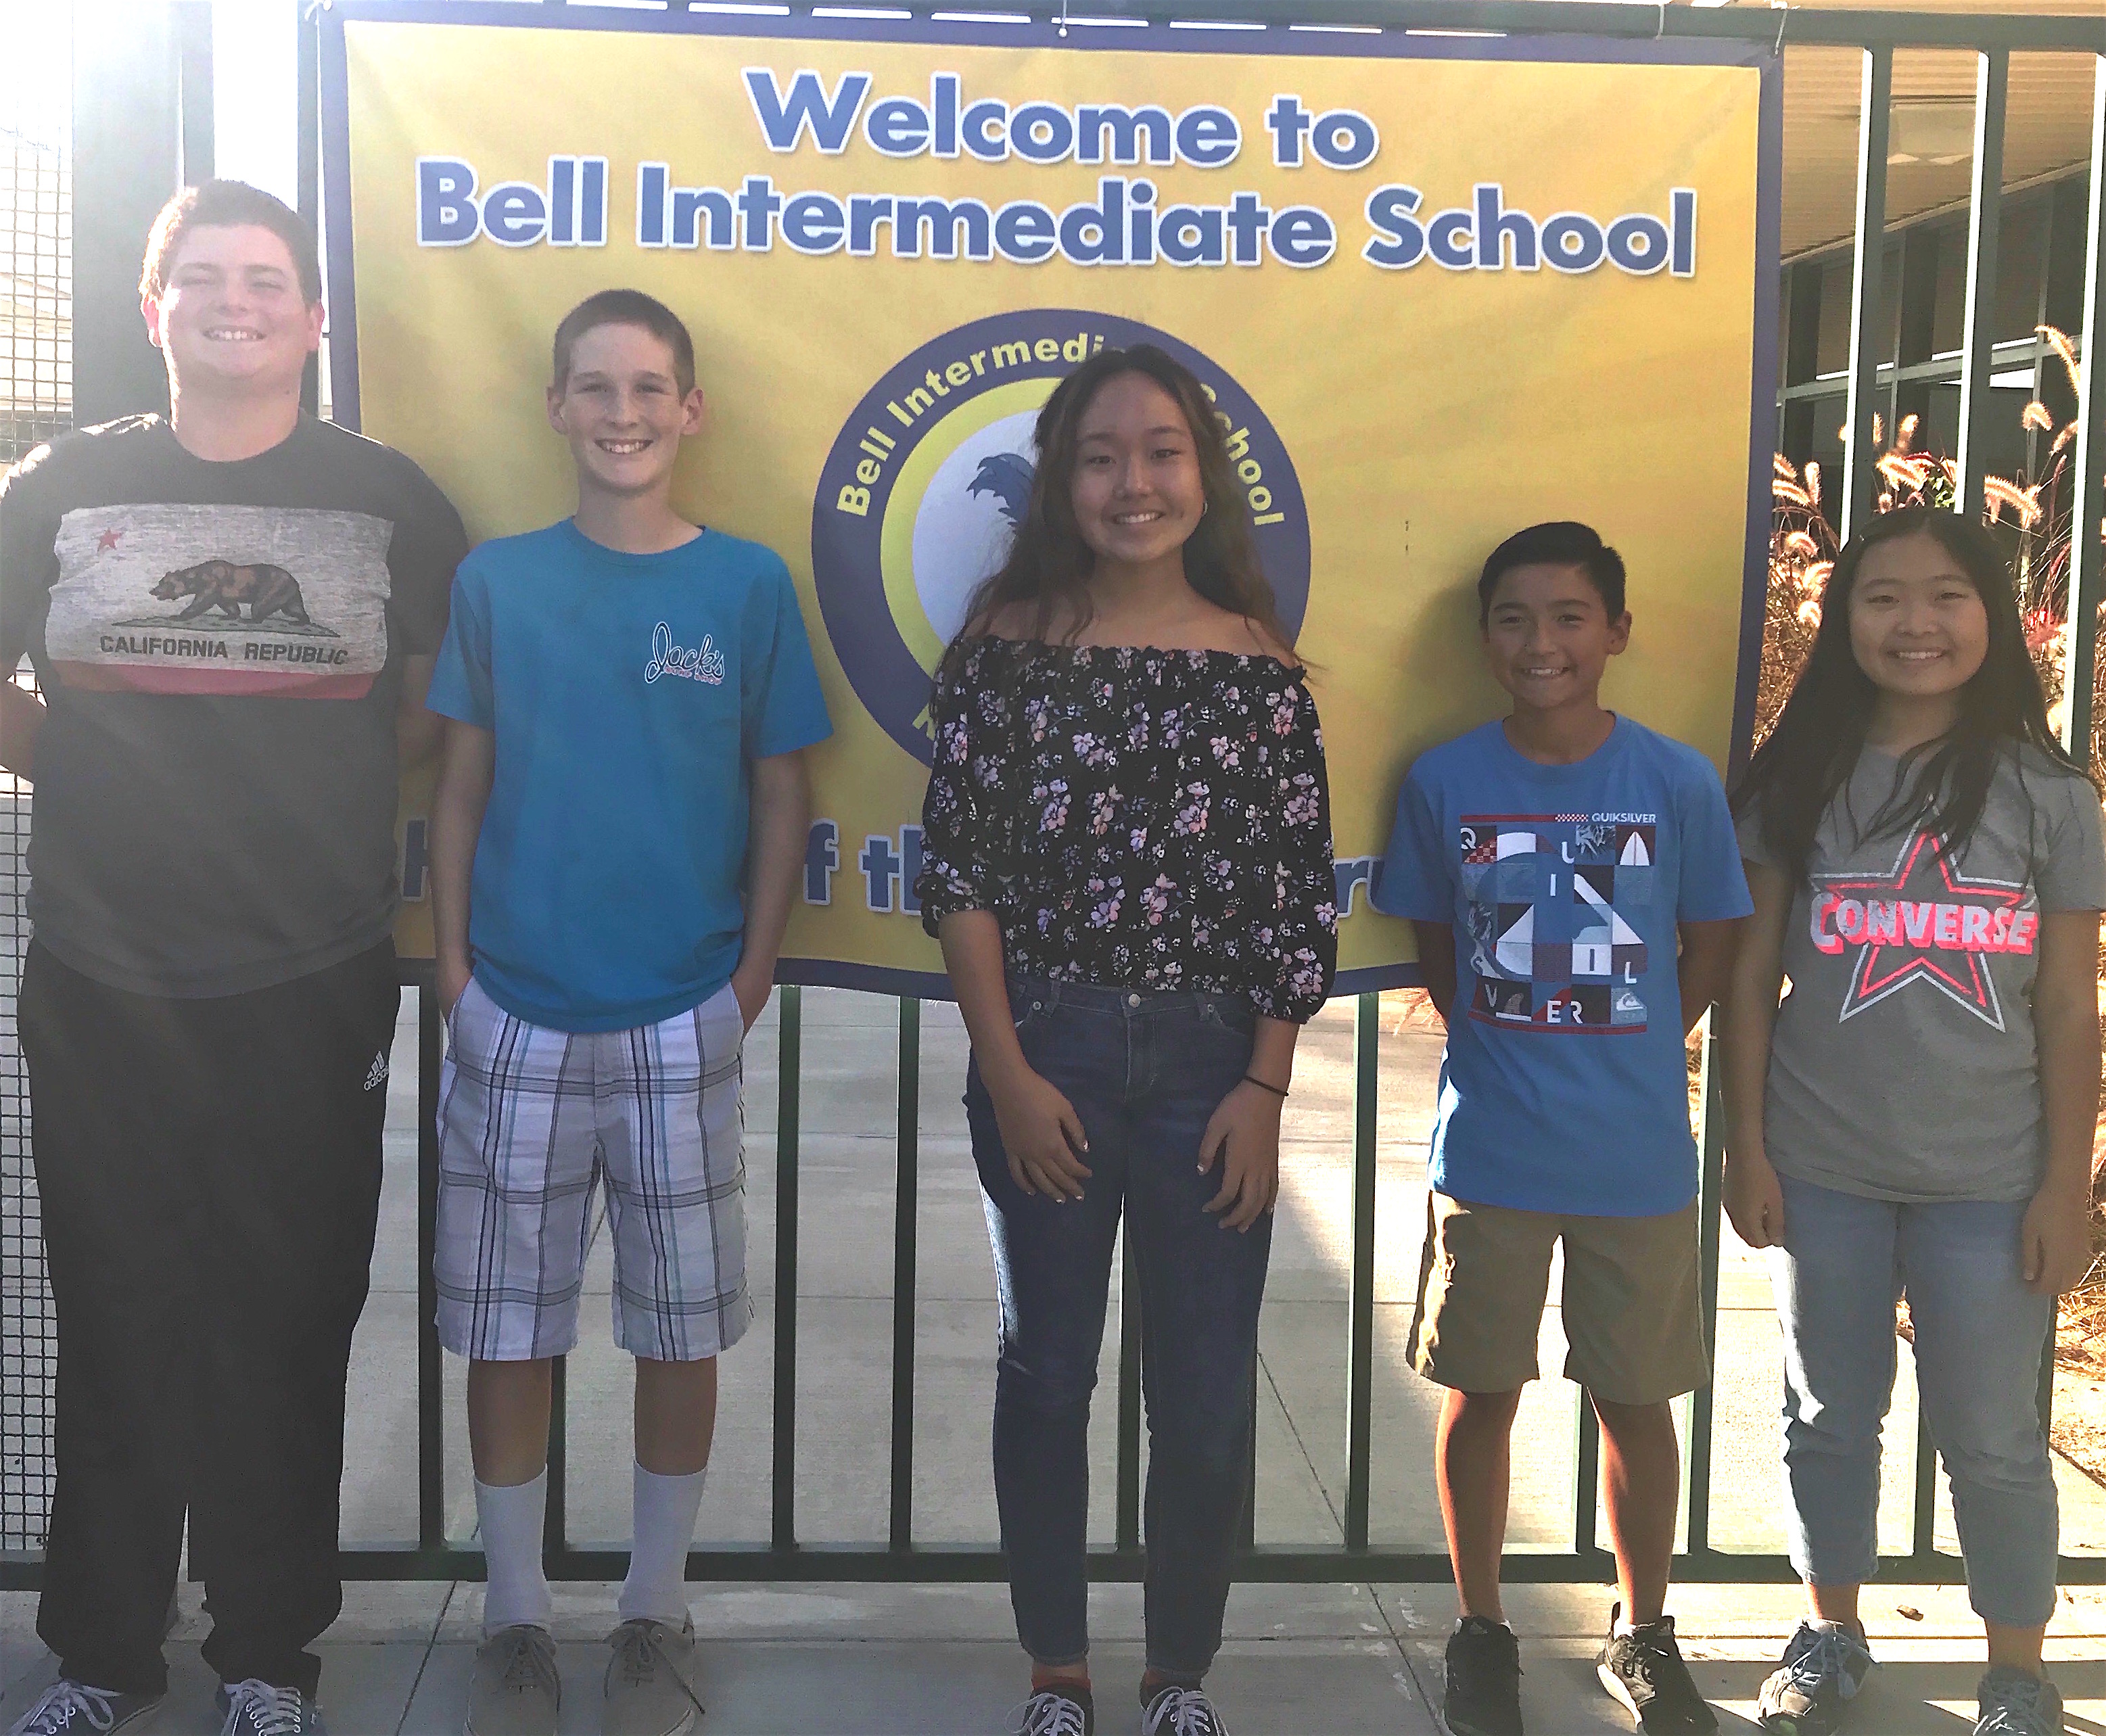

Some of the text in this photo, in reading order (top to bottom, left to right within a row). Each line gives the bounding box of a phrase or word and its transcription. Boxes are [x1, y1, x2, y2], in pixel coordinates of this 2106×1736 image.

[741, 67, 1380, 170] Welcome to
[415, 154, 1700, 279] Bell Intermediate School
[837, 426, 897, 517] Bell
[886, 332, 1125, 427] Intermedi
[100, 635, 348, 665] CALIFORNIA REPUBLIC
[1591, 813, 1657, 824] QUIKSILVER
[1810, 892, 2038, 955] CONVERSE
